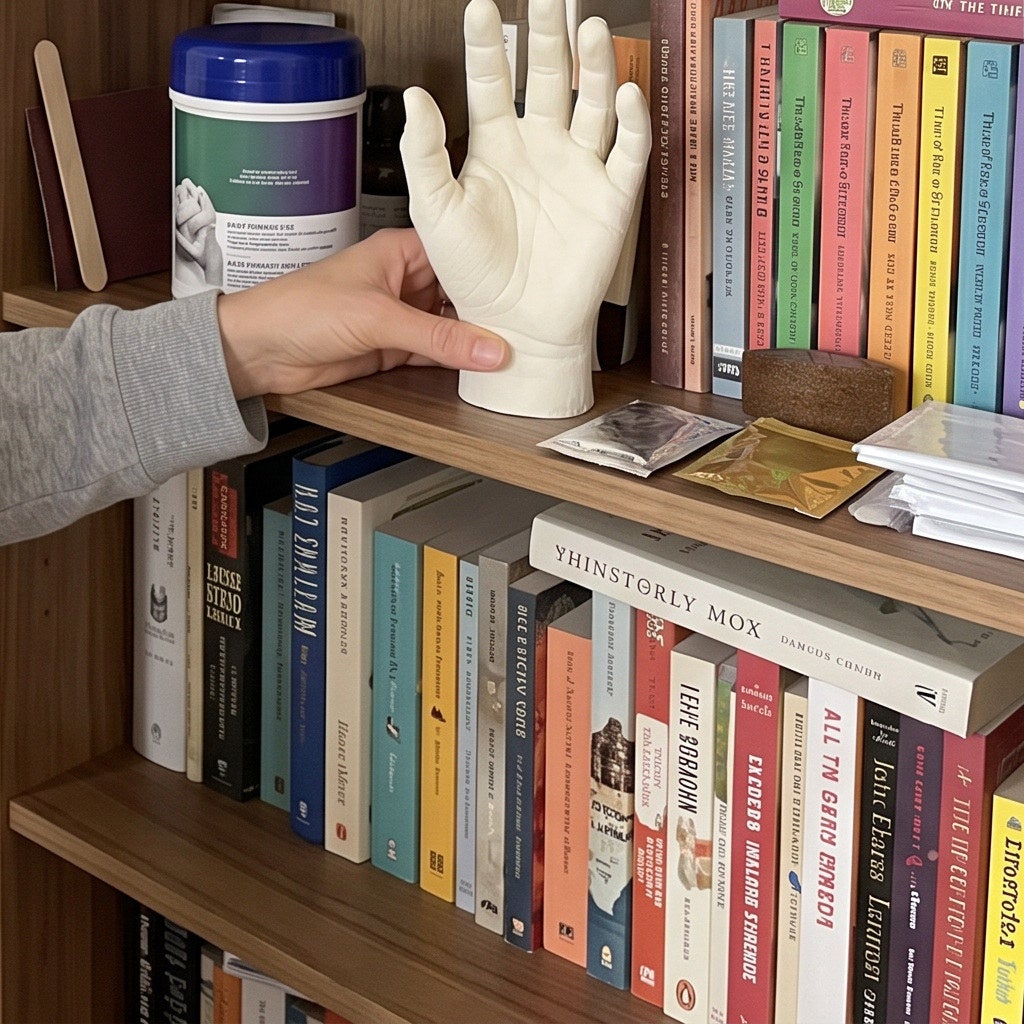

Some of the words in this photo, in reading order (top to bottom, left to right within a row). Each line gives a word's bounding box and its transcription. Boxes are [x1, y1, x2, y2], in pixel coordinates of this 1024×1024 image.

[960, 0, 985, 14] THE
[708, 603, 762, 640] MOX
[823, 707, 842, 745] ALL
